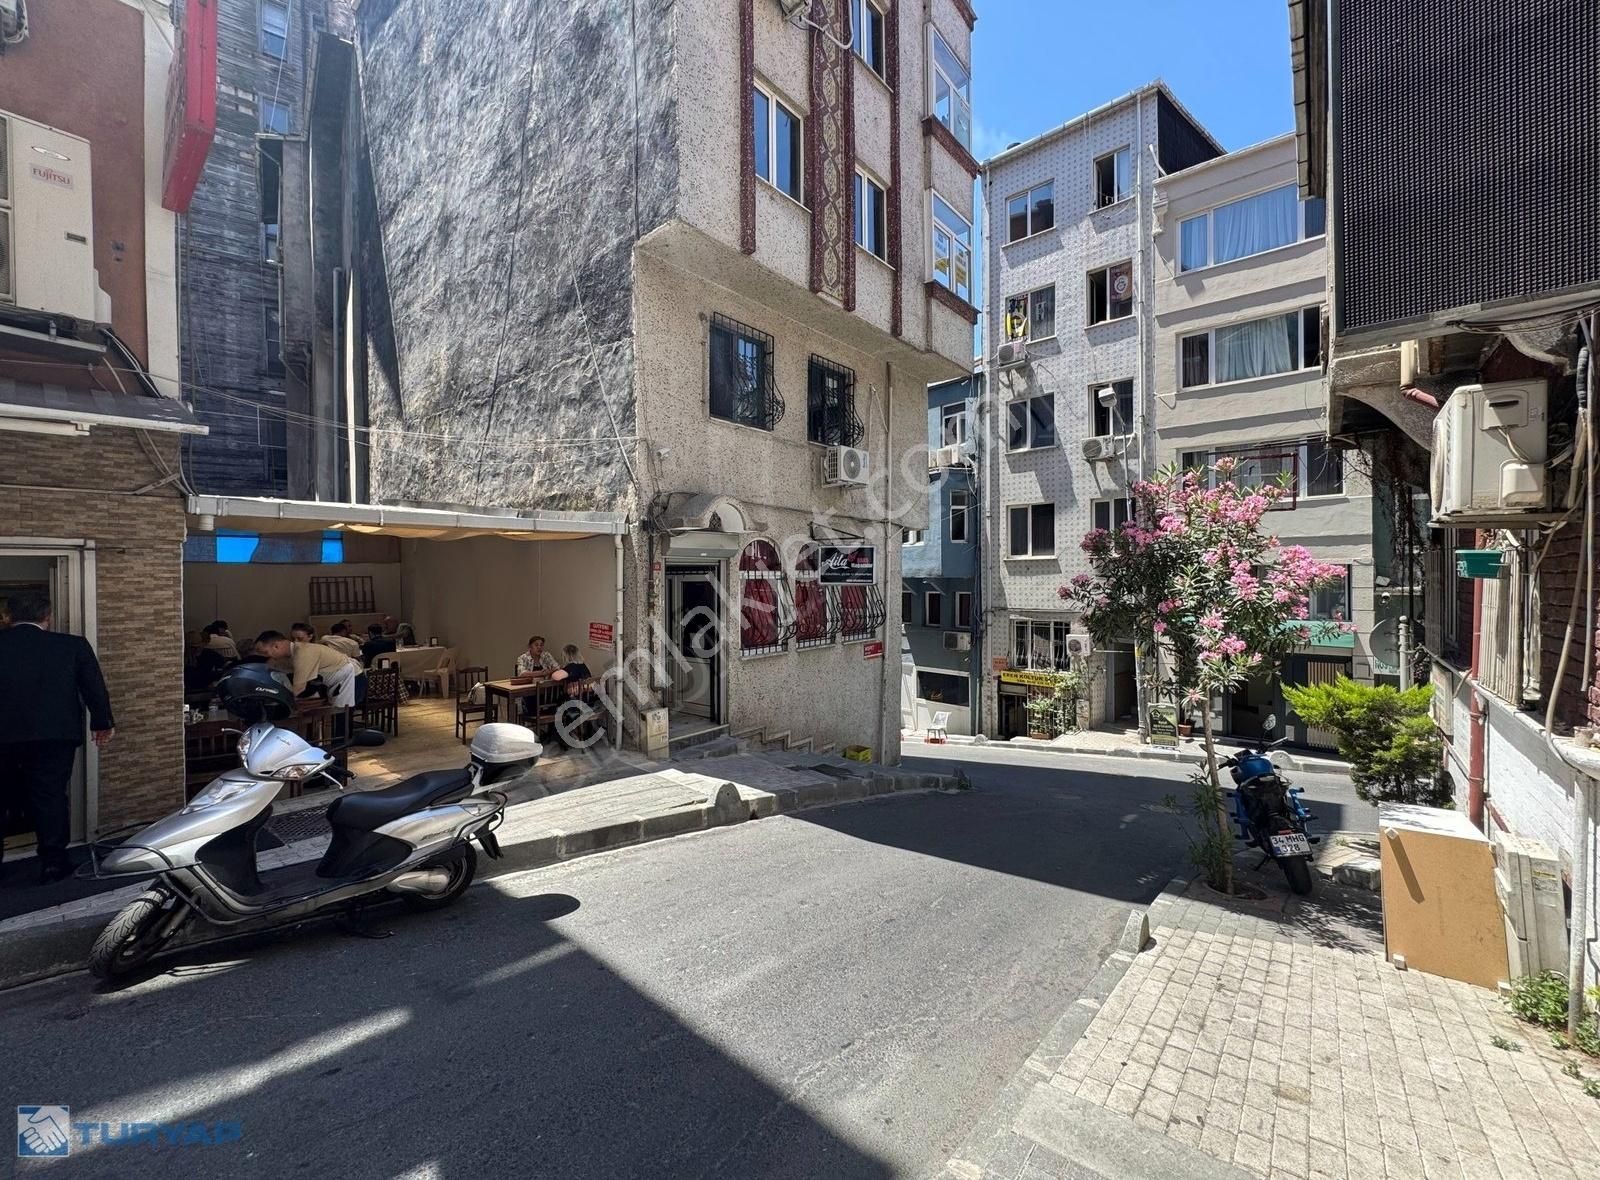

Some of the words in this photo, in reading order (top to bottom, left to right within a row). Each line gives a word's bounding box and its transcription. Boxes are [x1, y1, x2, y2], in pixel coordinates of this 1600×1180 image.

[33, 168, 70, 184] FUJITSU
[822, 552, 850, 569] Aila
[1282, 844, 1300, 852] 328
